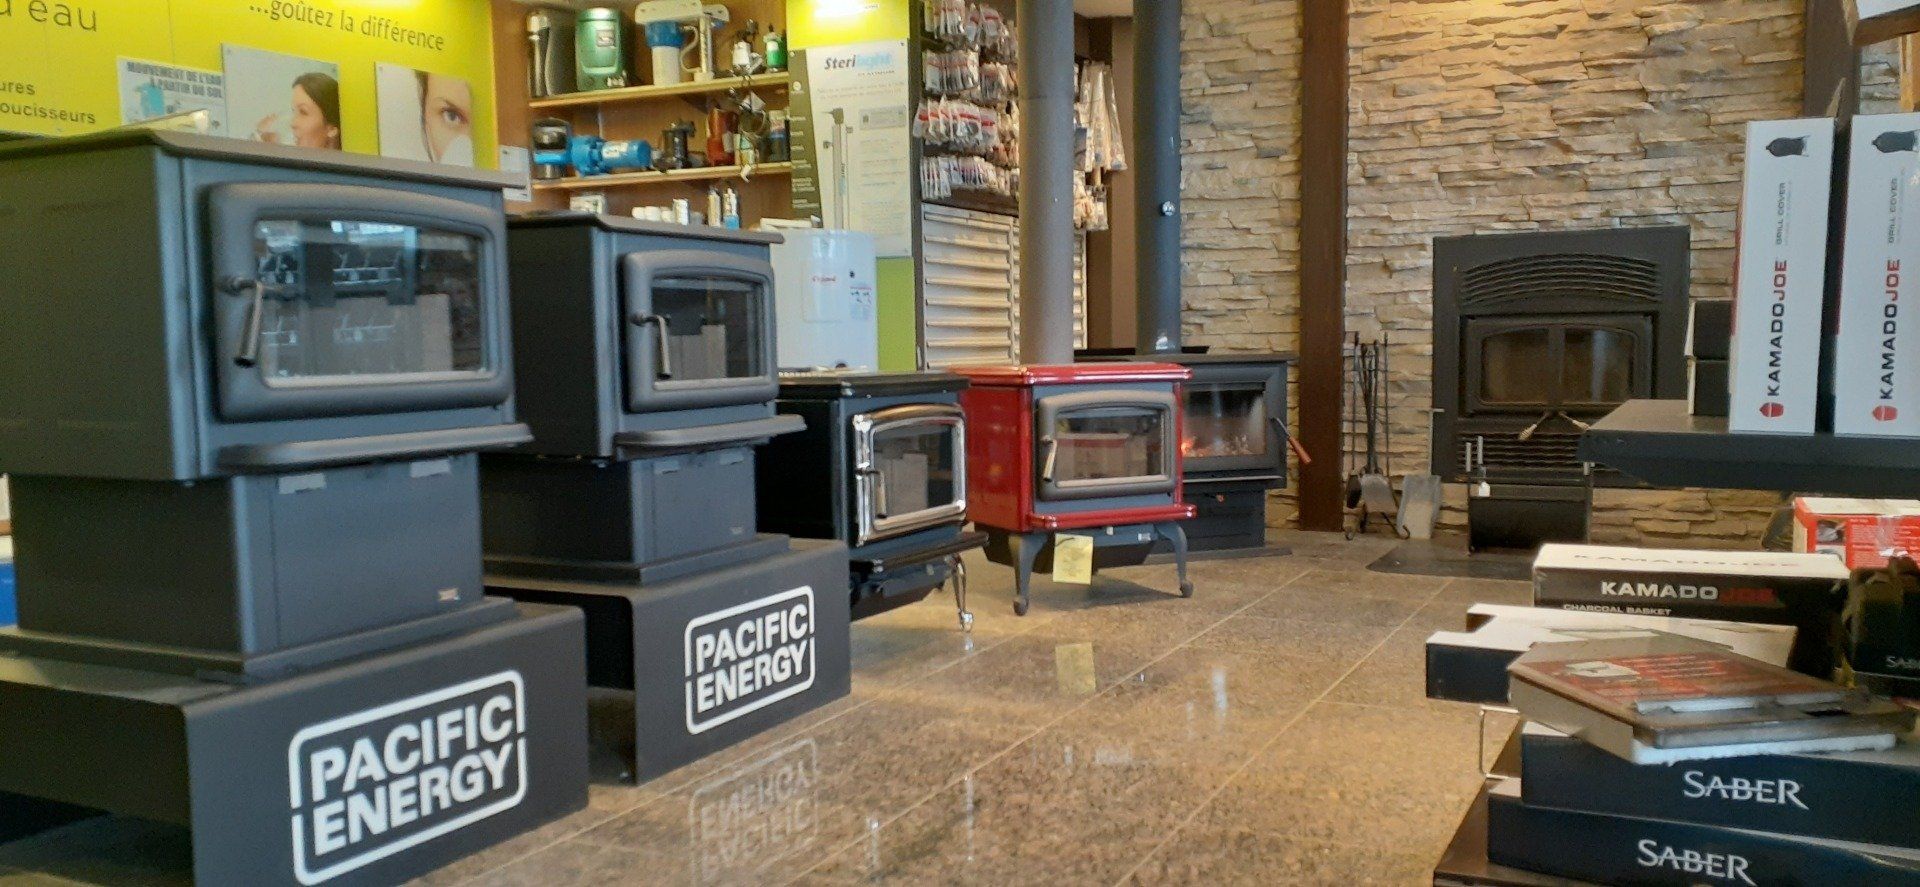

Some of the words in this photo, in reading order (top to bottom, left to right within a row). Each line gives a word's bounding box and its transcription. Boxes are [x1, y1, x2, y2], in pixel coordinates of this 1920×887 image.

[339, 10, 354, 32] la
[360, 15, 445, 51] différence
[206, 86, 222, 98] SOL
[1777, 182, 1786, 216] COVER
[1889, 177, 1898, 213] COVER
[1775, 218, 1784, 245] GRILL
[1766, 259, 1788, 397] KAMADOJOE
[1878, 258, 1901, 400] KAMADOJOE
[1563, 603, 1624, 614] CHARCOAL
[1626, 607, 1672, 617] BASKET
[1601, 580, 1776, 603] KAMADO
[696, 603, 809, 674] PACIFIC
[696, 640, 808, 714] ENERGY
[310, 694, 513, 802] PACIFIC
[313, 742, 513, 856] ENERGY
[1682, 770, 1810, 811] SABER
[1637, 838, 1758, 887] SABER
